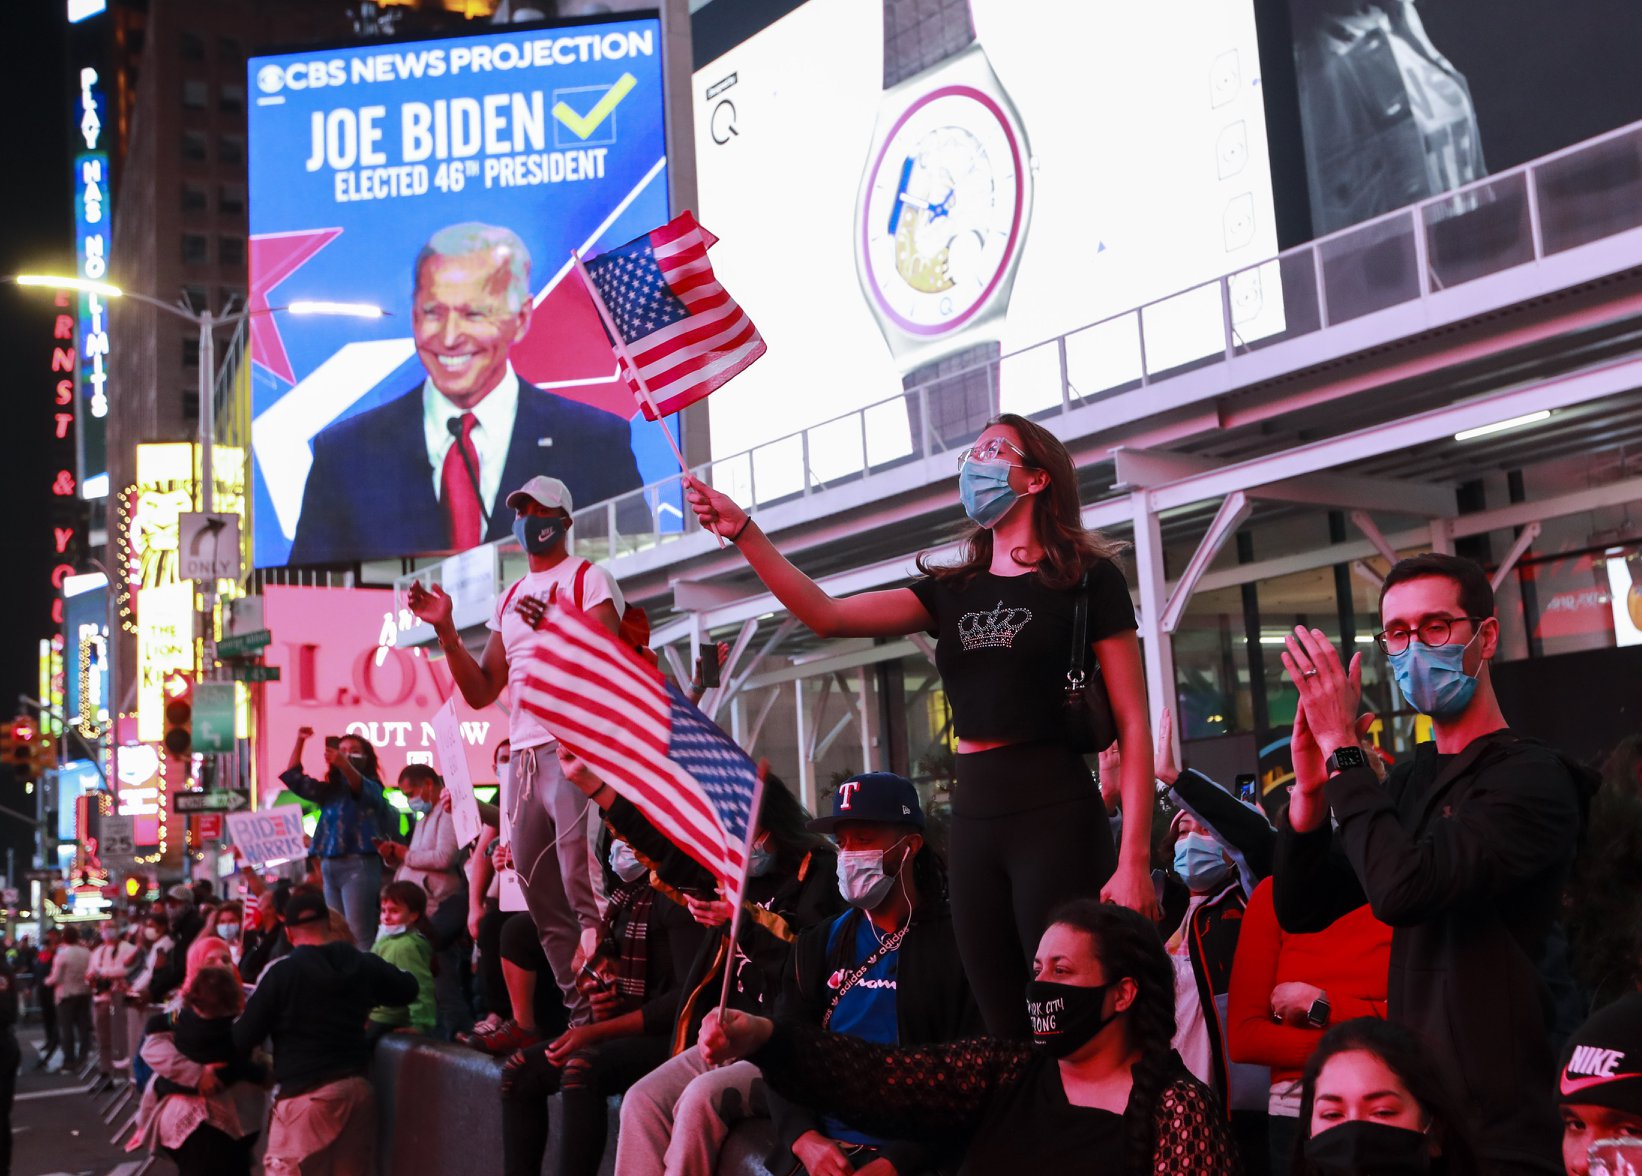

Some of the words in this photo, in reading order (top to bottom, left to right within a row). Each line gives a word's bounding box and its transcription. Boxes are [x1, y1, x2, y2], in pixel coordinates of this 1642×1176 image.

[285, 59, 347, 89] CBS
[351, 50, 446, 83] NEWS
[450, 30, 653, 72] PROJECTION
[80, 67, 101, 149] PLAY
[306, 105, 386, 172] JOE
[402, 91, 545, 163] BIDEN
[334, 165, 429, 202] ELECTED
[484, 148, 608, 189] PRESIDENT
[85, 235, 106, 279] NO
[86, 292, 109, 417] LIMITS
[187, 559, 231, 576] ONLY
[346, 721, 412, 746] OUT
[420, 721, 490, 746] NW
[839, 781, 862, 811] T
[235, 813, 302, 842] BIDEN
[104, 836, 132, 854] 25
[245, 837, 303, 864] HARRIS
[879, 927, 910, 955] adidas
[840, 965, 868, 996] adidas
[1567, 1045, 1625, 1077] NIKE
